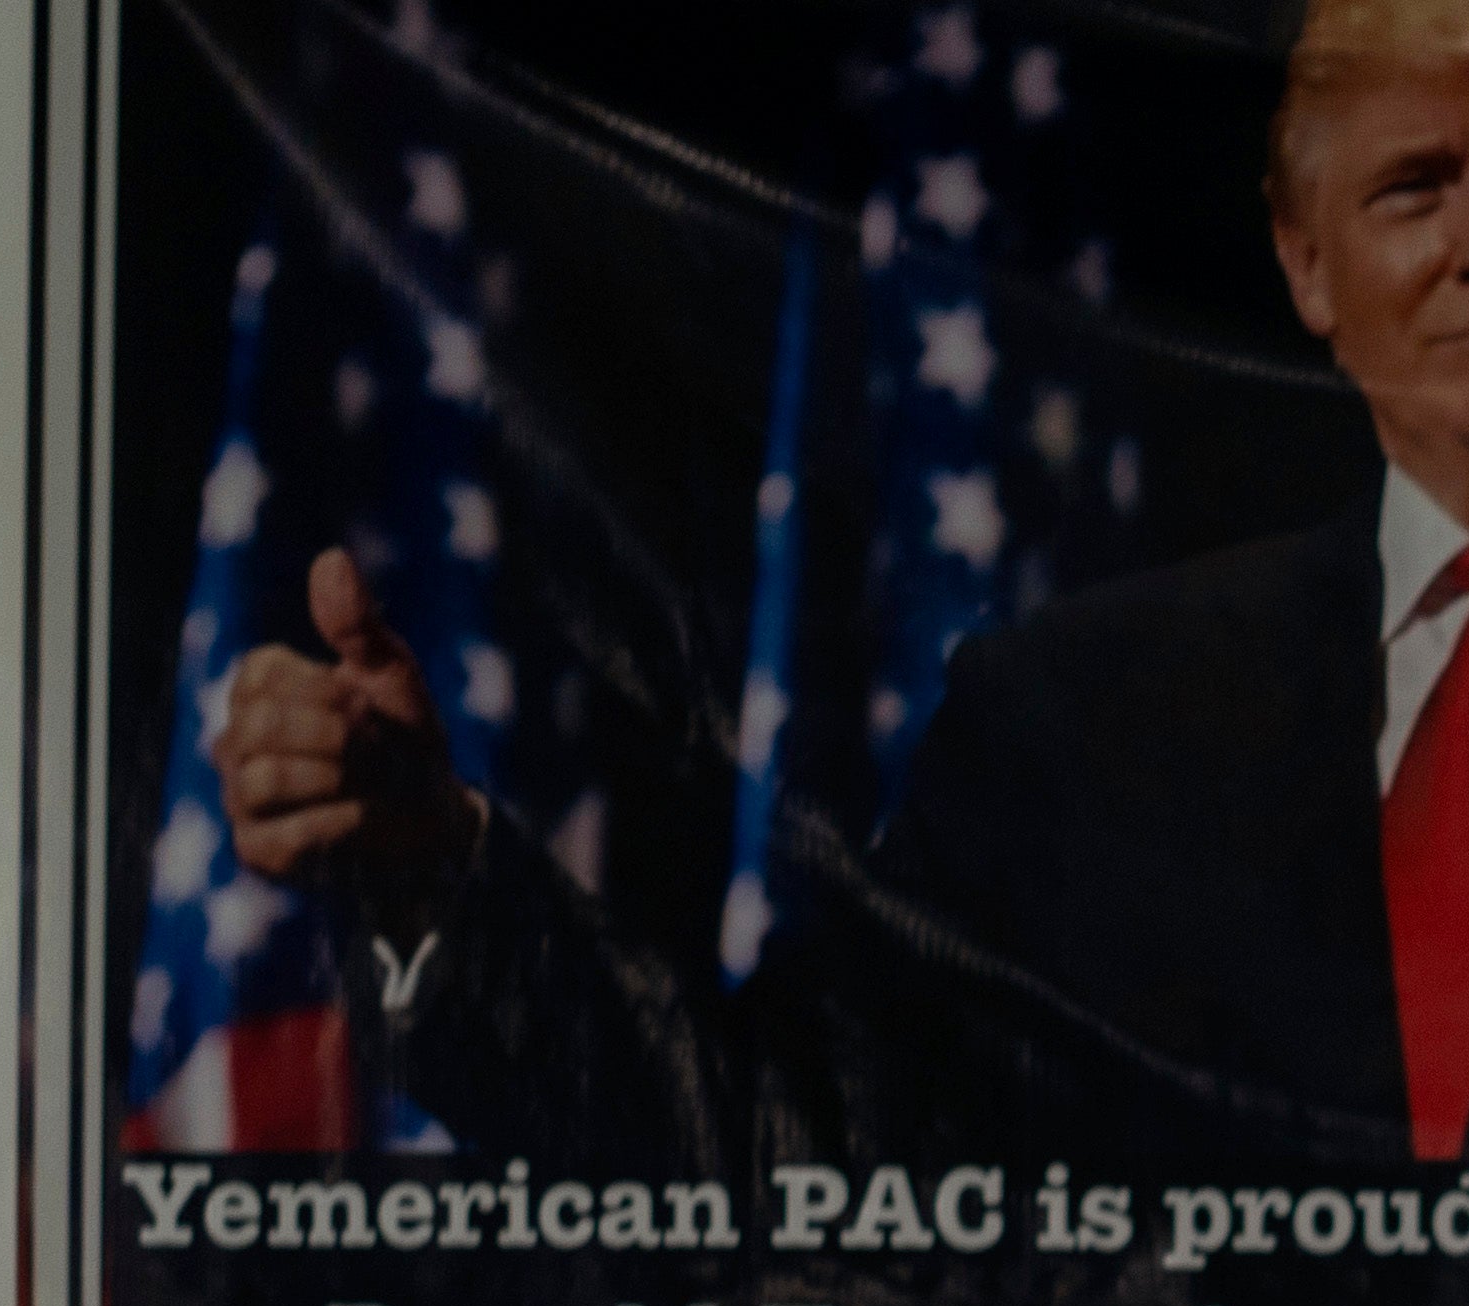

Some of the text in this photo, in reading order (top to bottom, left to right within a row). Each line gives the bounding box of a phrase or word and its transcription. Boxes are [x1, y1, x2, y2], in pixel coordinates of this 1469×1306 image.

[120, 1159, 740, 1250] Yemerican
[770, 1164, 1005, 1252] PAC
[1035, 1163, 1134, 1252] is
